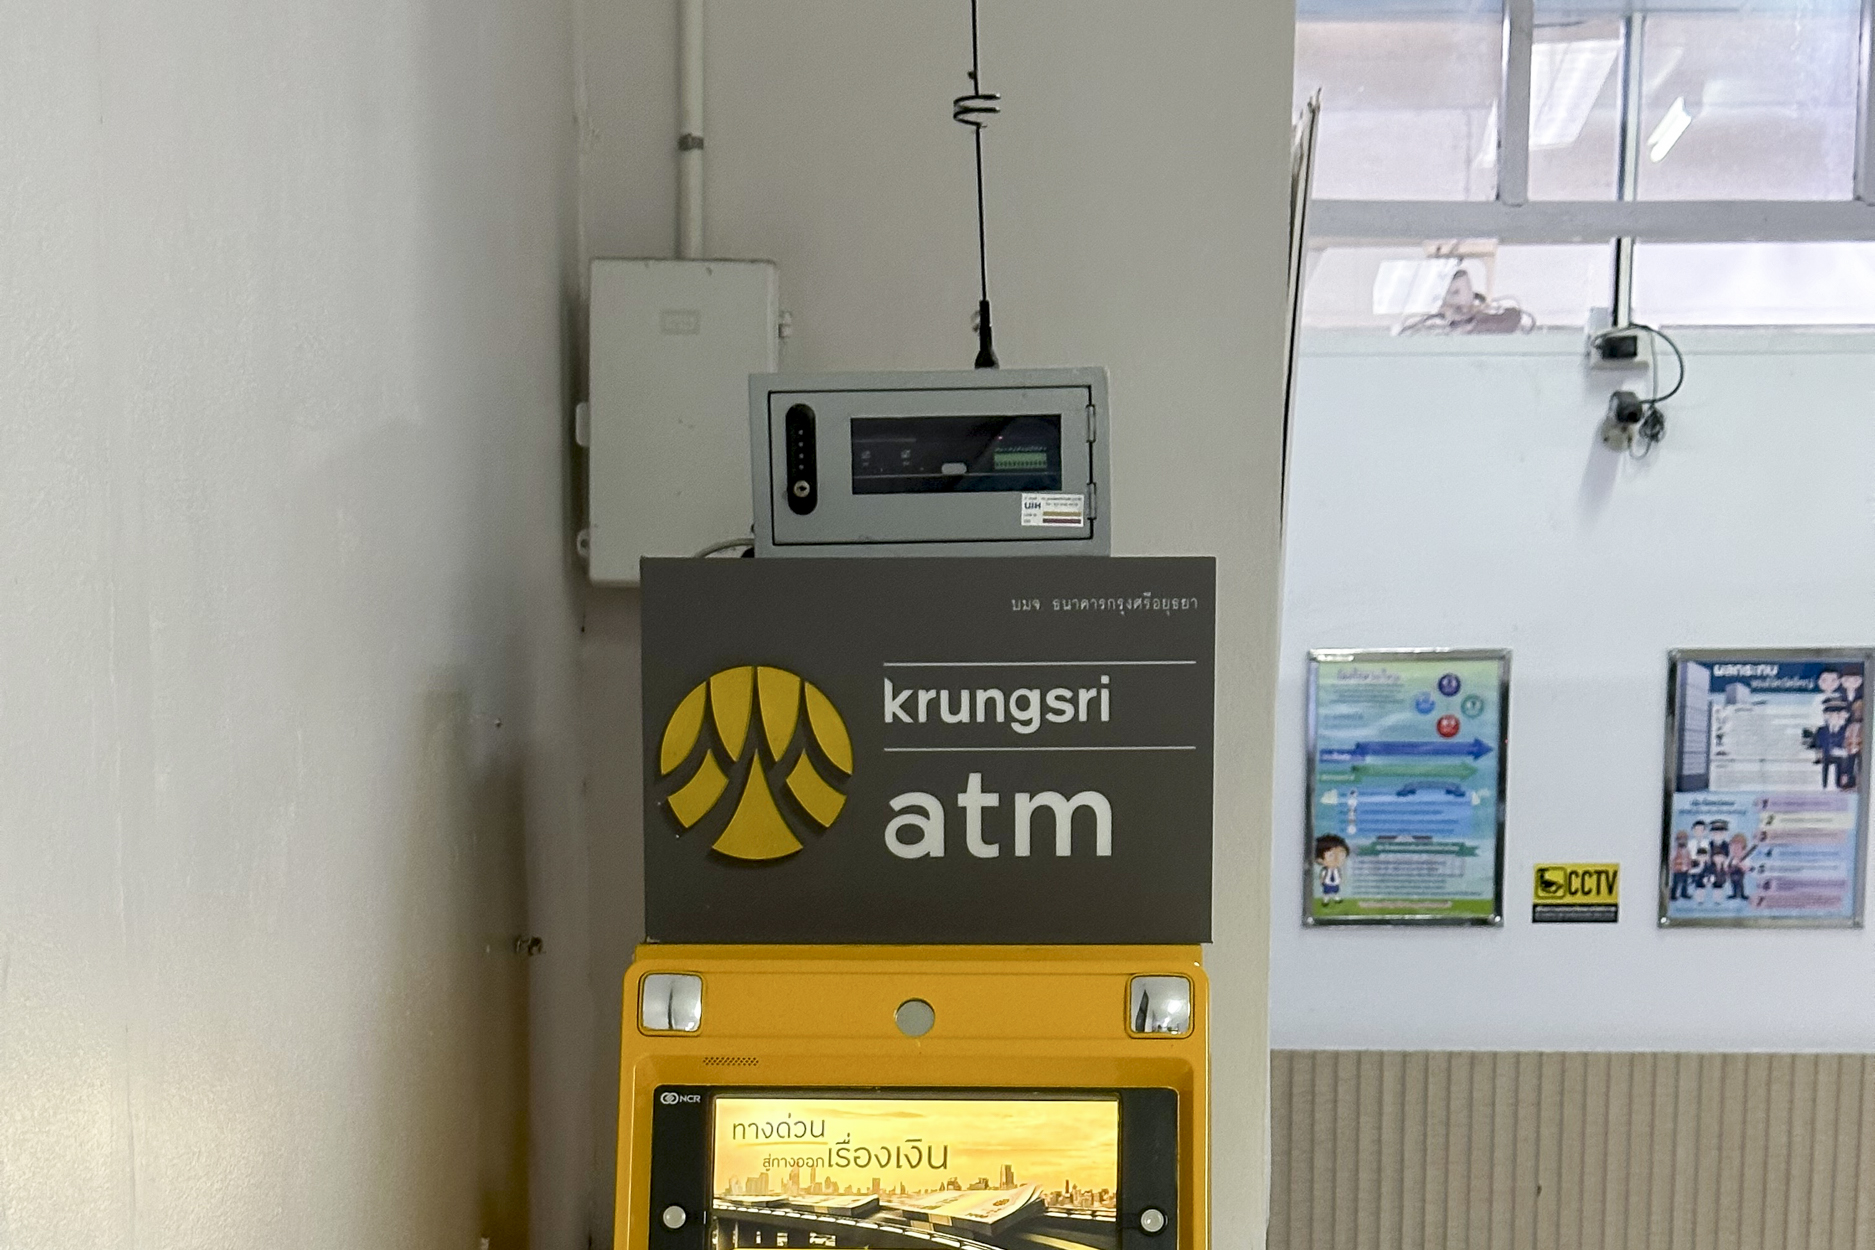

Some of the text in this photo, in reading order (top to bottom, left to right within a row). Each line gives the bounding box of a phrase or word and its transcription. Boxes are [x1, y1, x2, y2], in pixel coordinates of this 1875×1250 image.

[1012, 591, 1199, 617] บมจ ธนาคารกรุงศรีอยุธยา
[884, 675, 1111, 734] krungsri
[884, 772, 1113, 860] atm
[1568, 869, 1618, 896] CCTV
[679, 1094, 701, 1104] NCR
[733, 1112, 826, 1140] ทางด่วน
[763, 1132, 948, 1172] สู่ทางออก เรื่องเงิน
